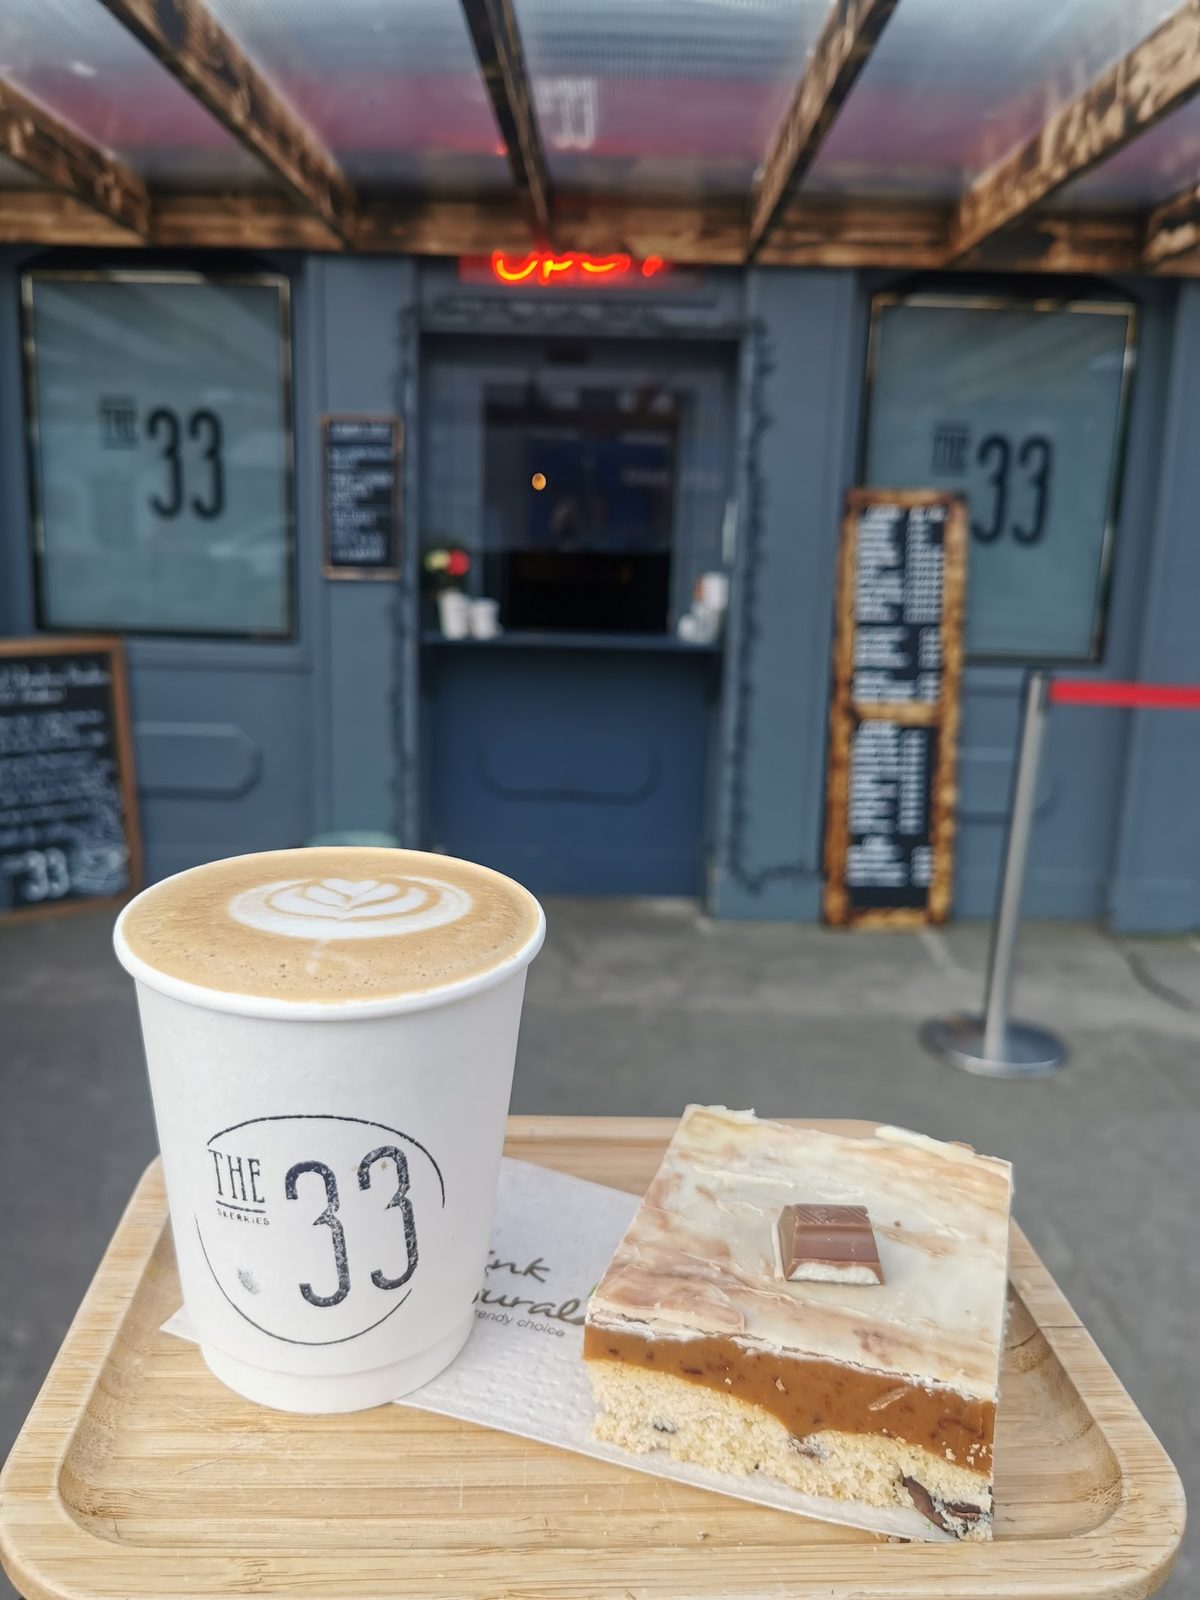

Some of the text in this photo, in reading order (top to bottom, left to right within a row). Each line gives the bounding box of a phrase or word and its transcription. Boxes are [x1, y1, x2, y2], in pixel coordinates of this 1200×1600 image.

[147, 407, 224, 520] 33
[972, 432, 1052, 547] 33
[208, 1145, 418, 1308] THE 33
[484, 1250, 550, 1283] ink
[474, 1309, 566, 1338] rendy choice
